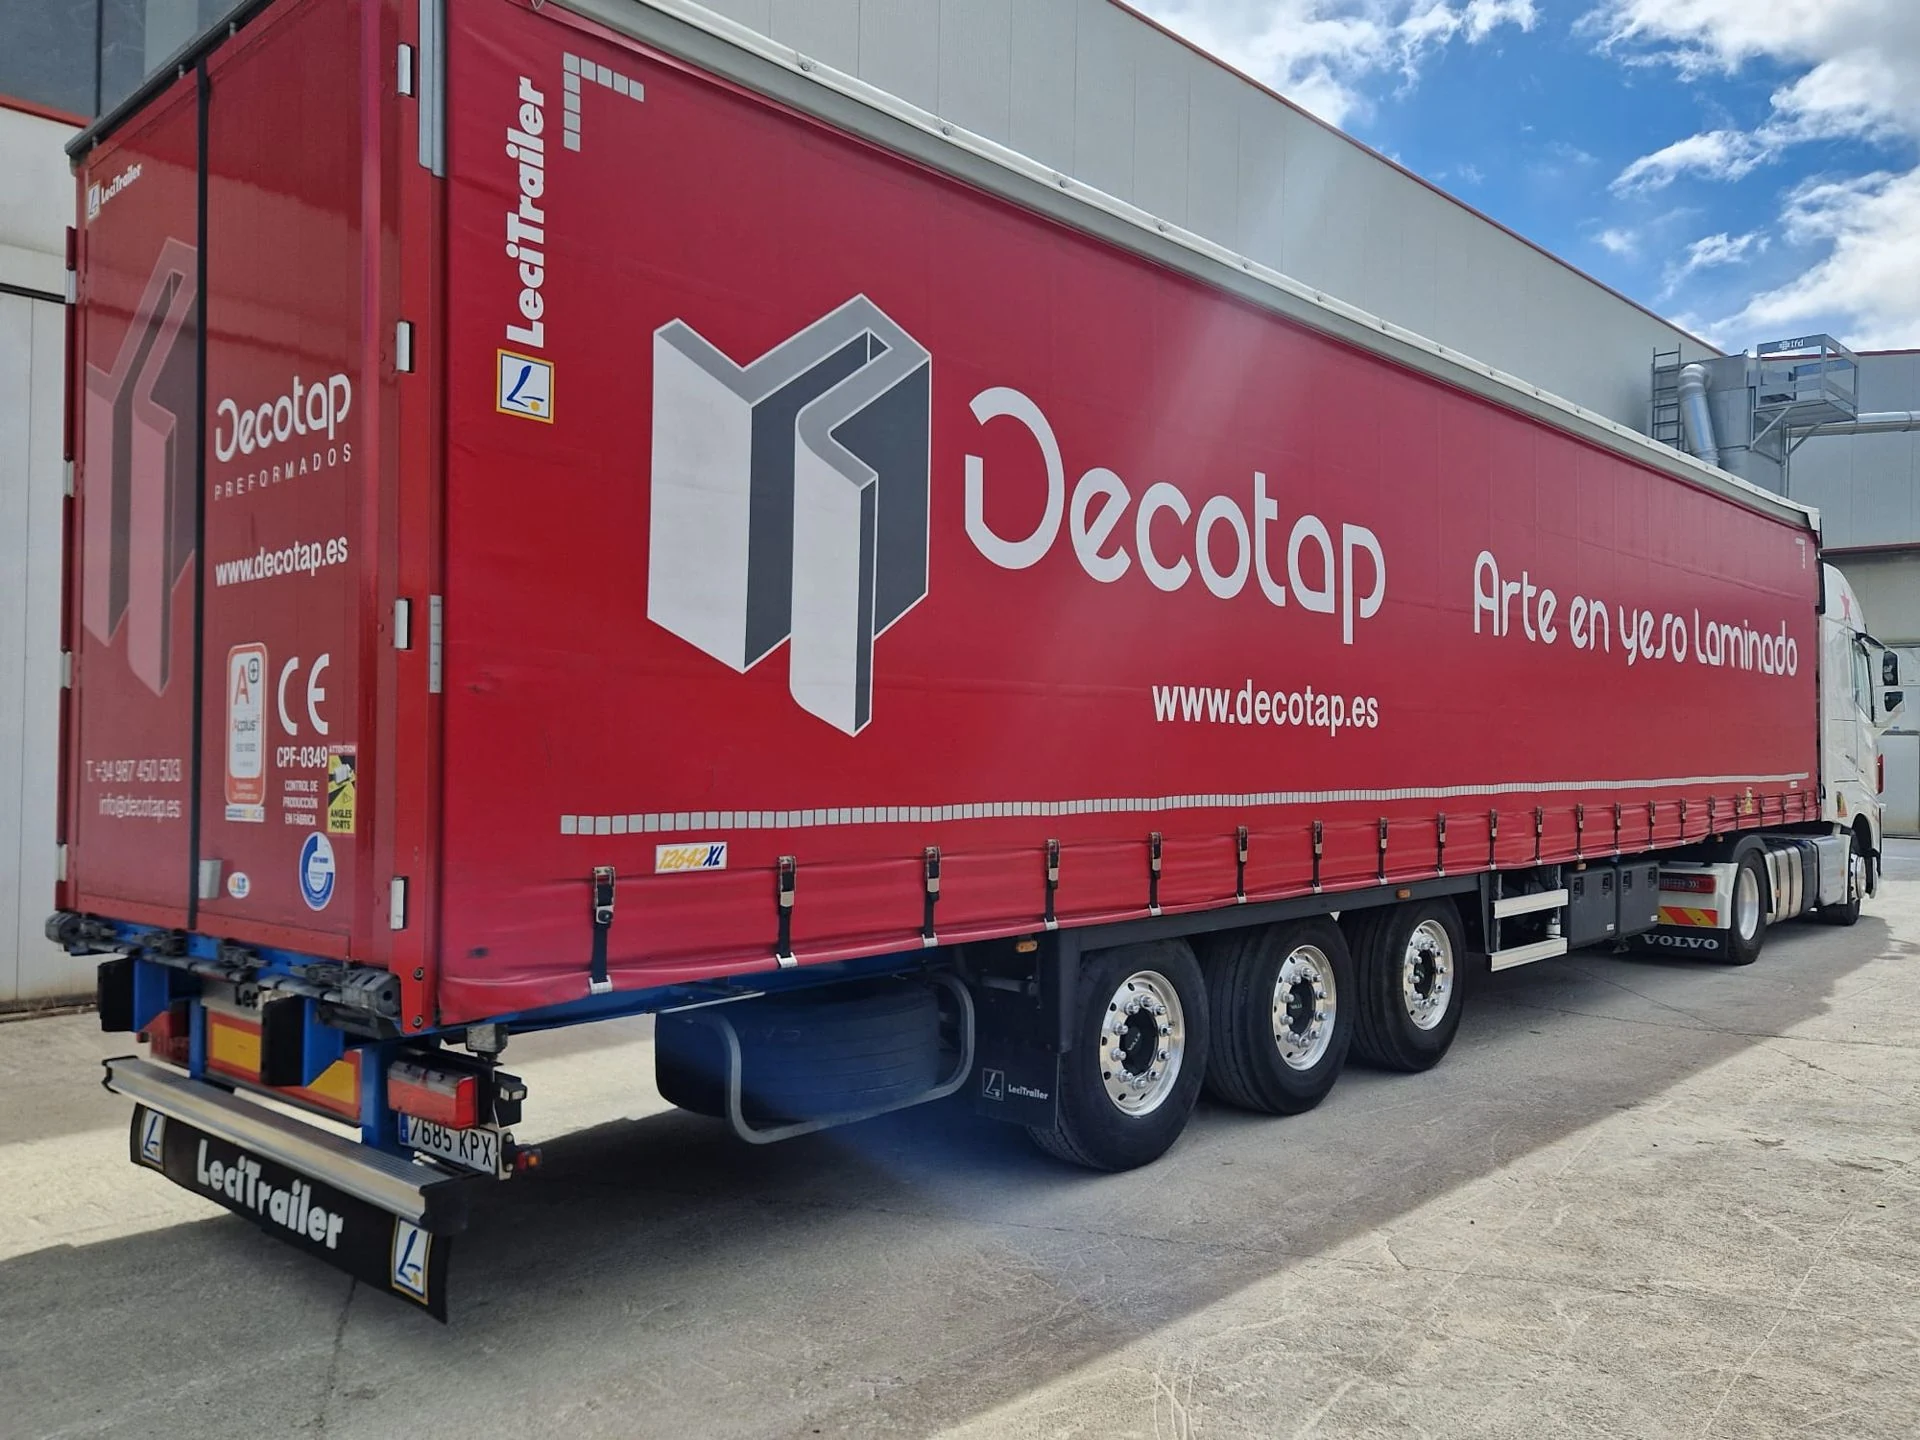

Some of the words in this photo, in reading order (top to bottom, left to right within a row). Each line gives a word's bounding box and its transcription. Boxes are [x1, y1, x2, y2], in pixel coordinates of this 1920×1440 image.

[506, 75, 545, 349] LeciTrailer
[215, 373, 352, 463] Decotap
[214, 443, 351, 501] PREFORMADOS
[965, 386, 1386, 645] Decotap
[215, 536, 349, 587] www.decotap.es
[1474, 550, 1558, 644] Arte
[1569, 595, 1610, 653] en
[1618, 605, 1688, 666] yeso
[278, 653, 330, 736] CE
[1151, 679, 1380, 737] www.decotap.es
[276, 745, 328, 769] CPF-0349
[330, 809, 353, 819] ANGLES
[330, 820, 352, 829] MORTS
[1641, 934, 1719, 950] VOLVO
[1008, 1084, 1049, 1100] LeciTrailer
[459, 1128, 492, 1167] KPX
[197, 1139, 344, 1250] LeciTrailer
